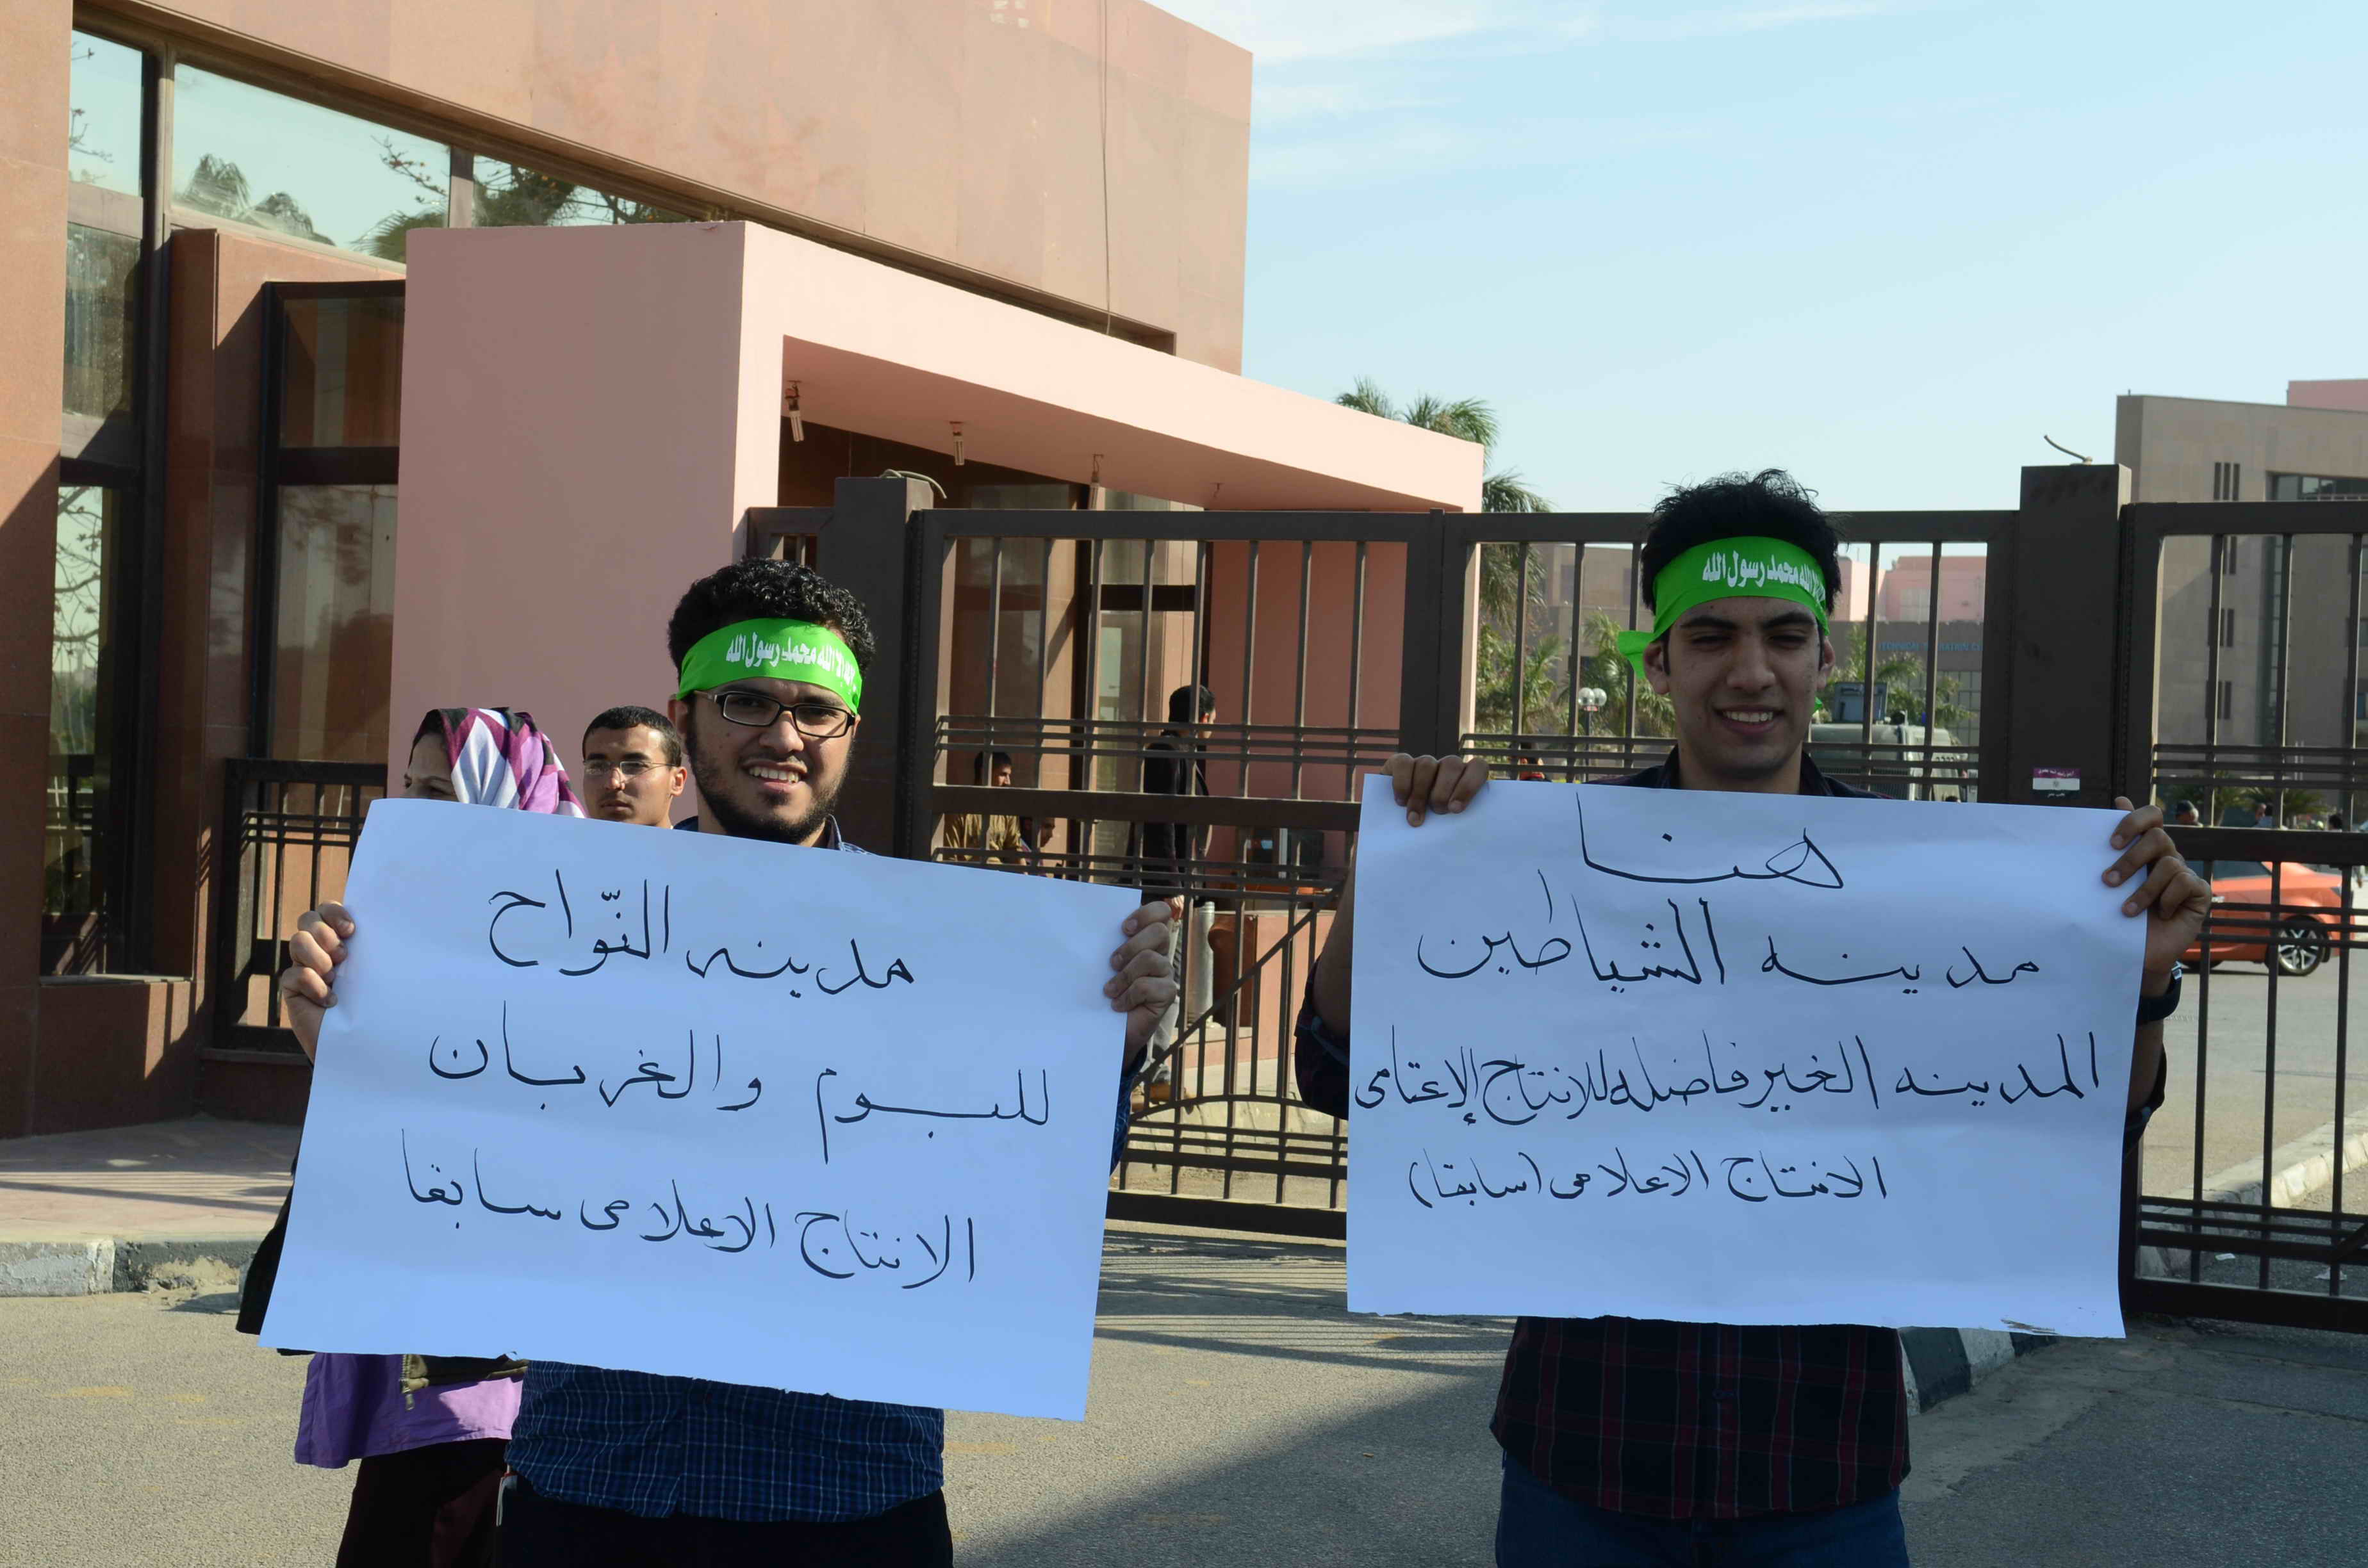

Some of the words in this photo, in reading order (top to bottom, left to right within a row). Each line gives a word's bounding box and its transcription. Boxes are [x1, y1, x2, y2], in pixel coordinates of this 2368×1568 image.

[1702, 551, 1727, 582] الله
[1727, 550, 1766, 588] رسول
[1766, 554, 1799, 584] محمد
[725, 633, 746, 662] الله
[745, 632, 780, 668] رسول
[781, 637, 816, 666] محمد
[1575, 792, 1845, 890] هنا
[1417, 868, 1725, 994] الشياطين
[1737, 1035, 1879, 1113] الغير
[816, 1068, 1049, 1166] للبوم
[401, 1128, 562, 1231] سابقا
